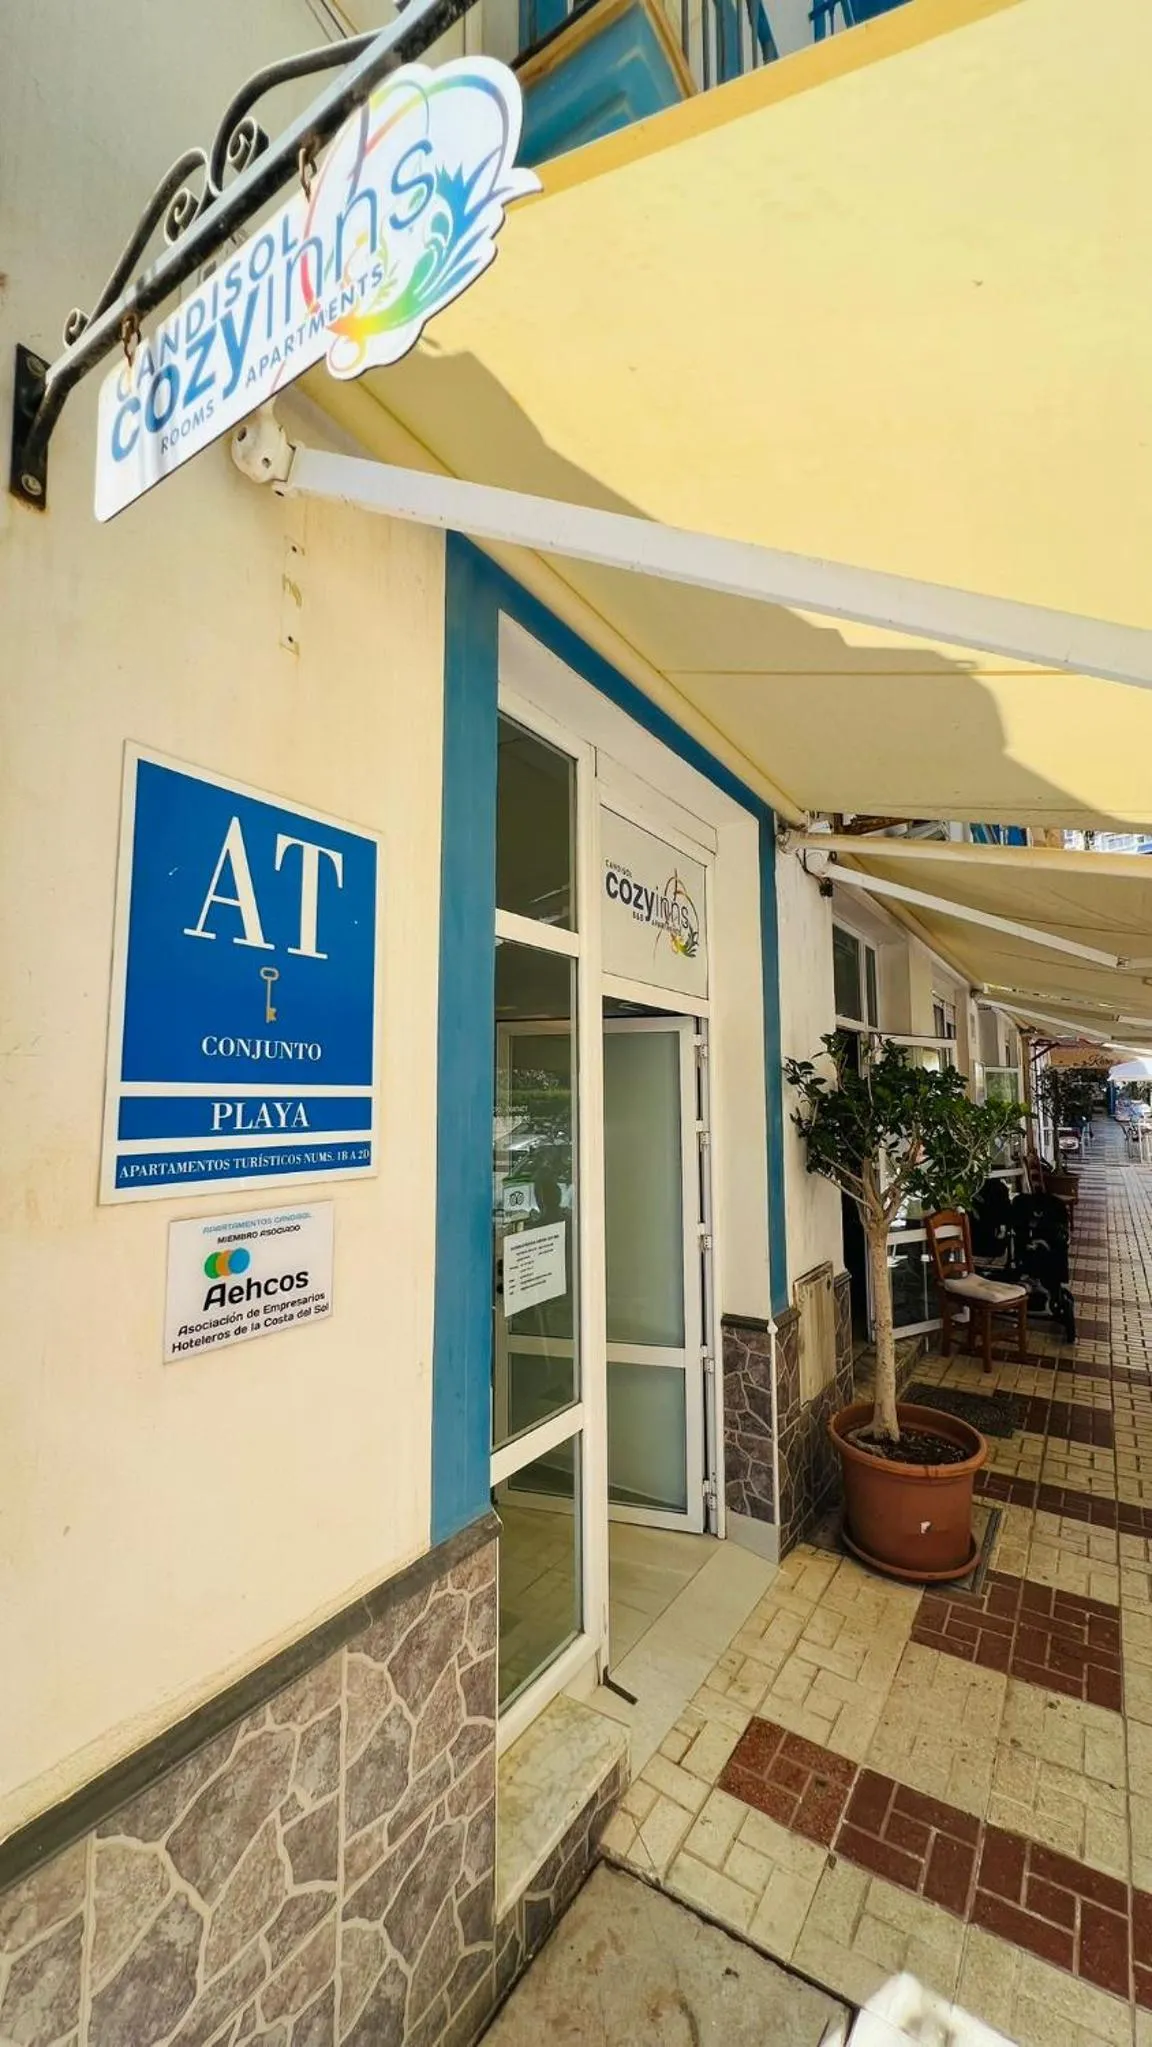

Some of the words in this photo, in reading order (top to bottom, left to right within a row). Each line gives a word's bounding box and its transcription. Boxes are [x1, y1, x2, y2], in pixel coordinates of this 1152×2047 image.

[117, 214, 298, 402] CANDISOL
[160, 399, 215, 454] ROOMS
[245, 263, 383, 388] APARTMENTS
[183, 816, 343, 959] AT
[202, 1035, 322, 1061] CONJUNTO
[210, 1101, 309, 1131] PLAYA
[120, 1158, 230, 1178] APARTAMENTOS
[233, 1153, 301, 1169] TURÍSTICOS
[303, 1151, 335, 1164] NUMS.
[217, 1230, 258, 1244] MIEMBRO
[259, 1224, 301, 1238] ASOCIADO
[202, 1271, 309, 1311] Aehcos
[171, 1329, 231, 1353] Hoteleros
[234, 1325, 248, 1336] de
[250, 1321, 261, 1332] la
[264, 1313, 294, 1328] Costa
[297, 1308, 312, 1319] del
[314, 1302, 329, 1315] Sol
[177, 1311, 243, 1337] Asociación
[246, 1308, 260, 1319] de
[263, 1292, 326, 1314] Empresarios
